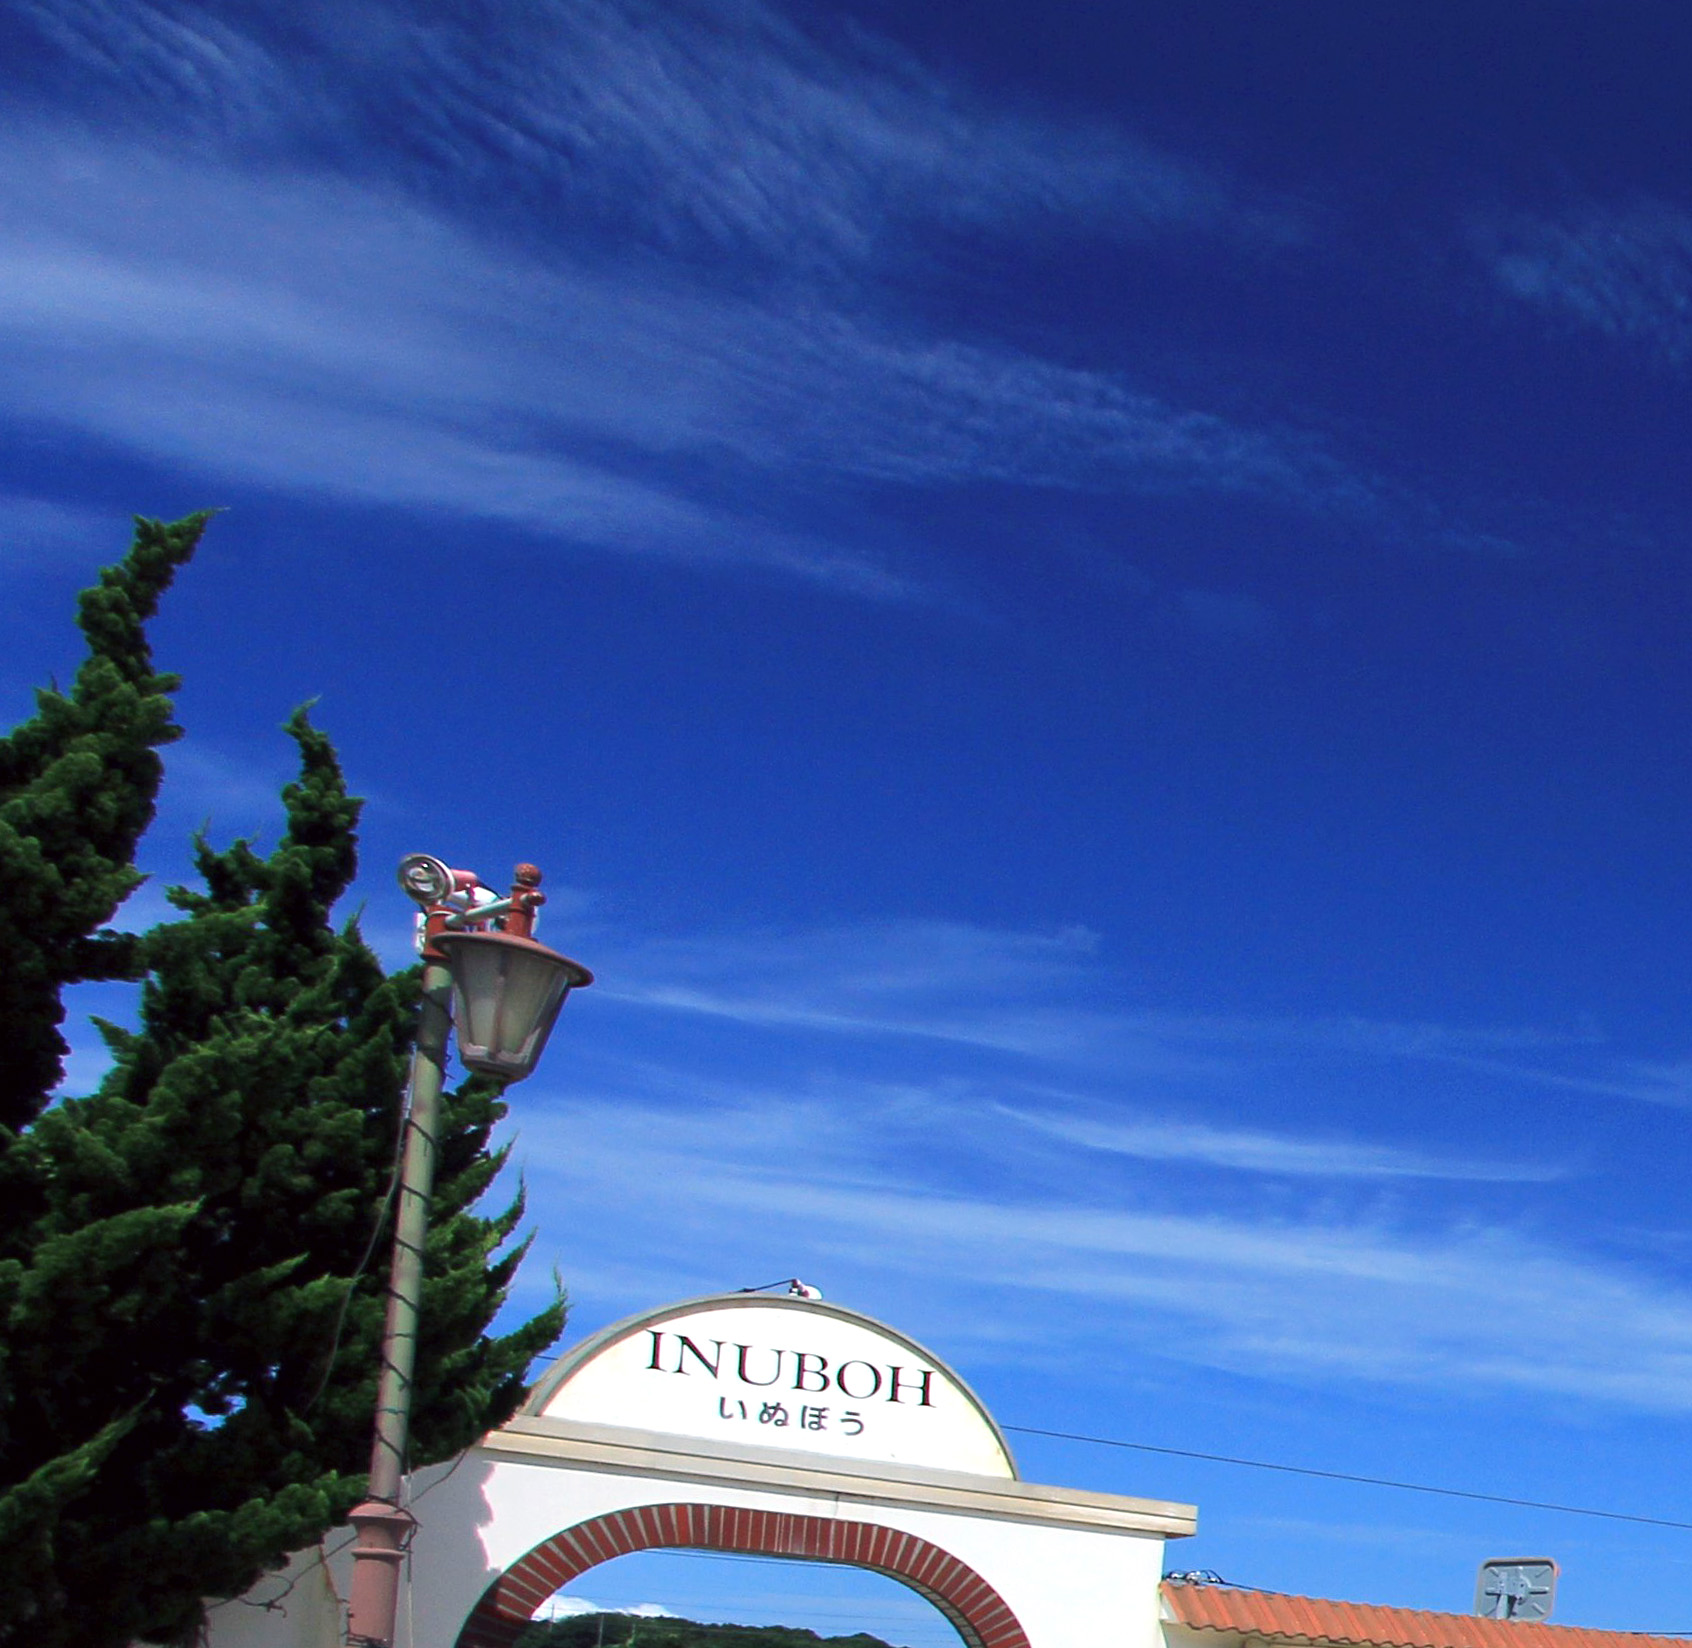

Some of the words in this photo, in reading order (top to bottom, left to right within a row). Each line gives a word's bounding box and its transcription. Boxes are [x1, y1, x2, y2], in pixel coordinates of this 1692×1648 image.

[645, 1329, 938, 1408] INUBOH
[719, 1396, 865, 1436] いぬぼう
